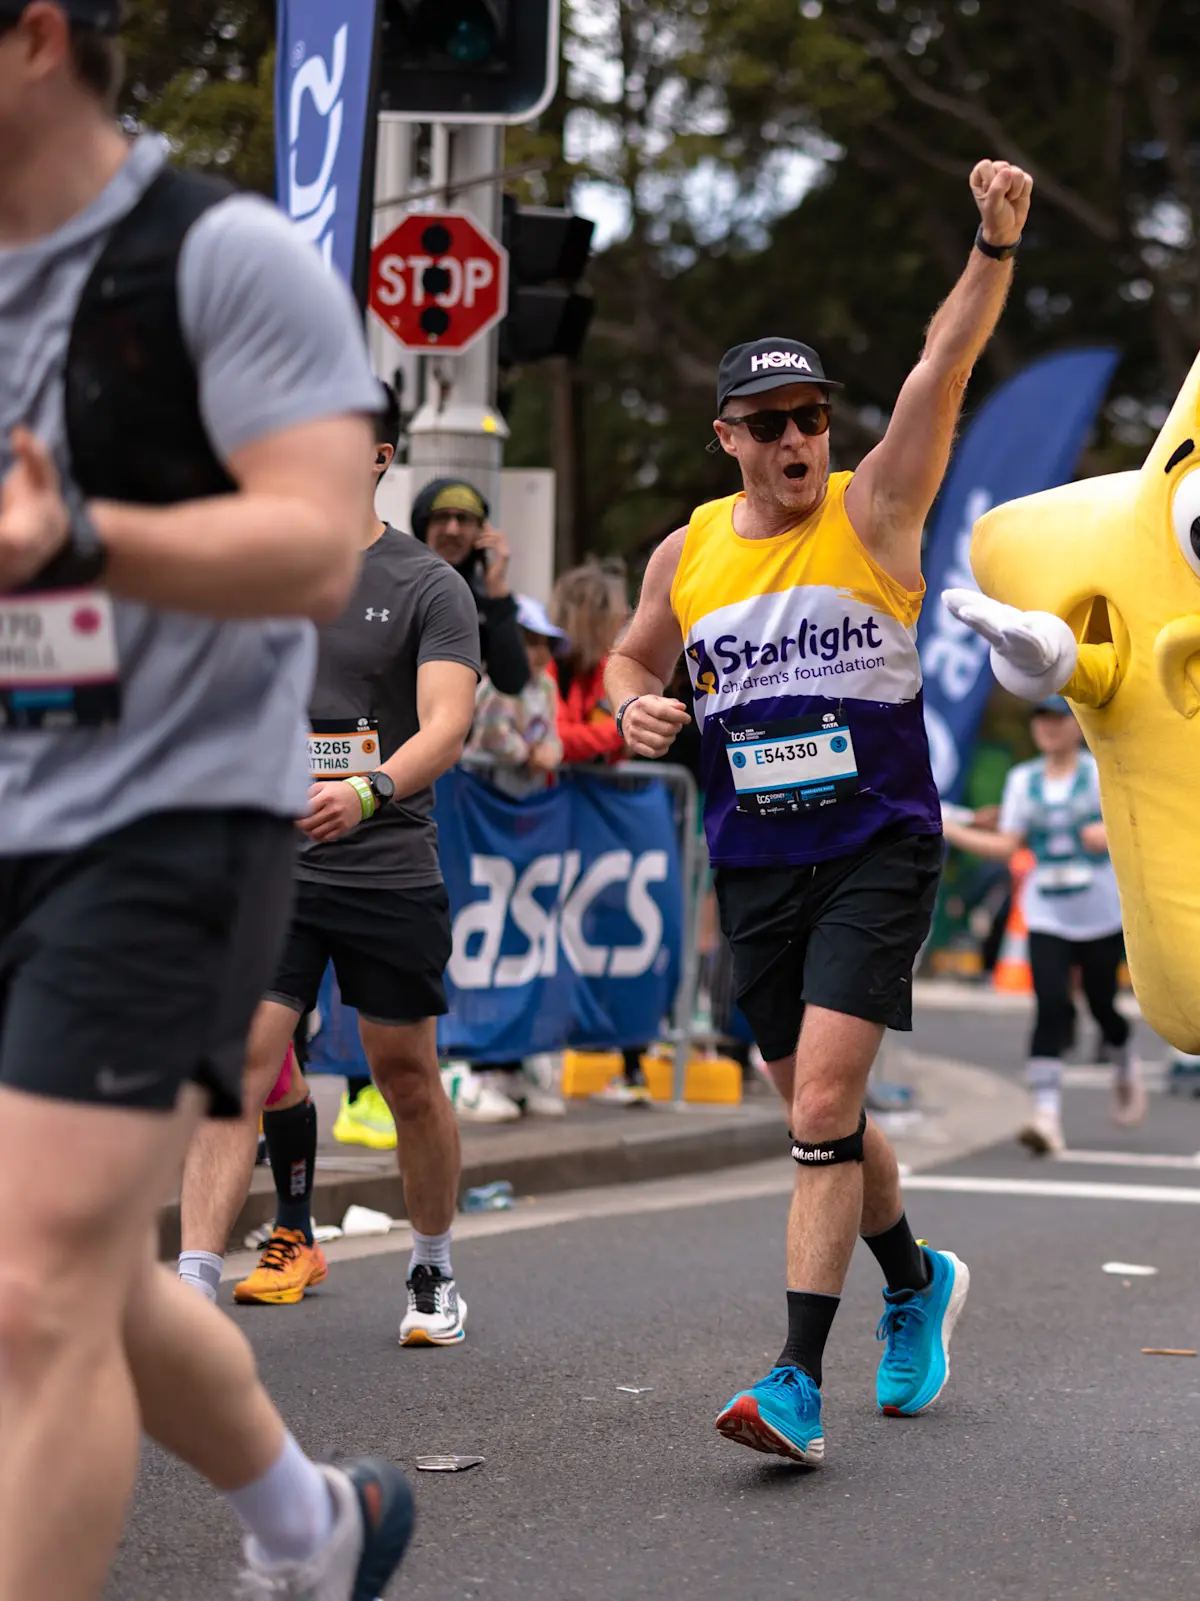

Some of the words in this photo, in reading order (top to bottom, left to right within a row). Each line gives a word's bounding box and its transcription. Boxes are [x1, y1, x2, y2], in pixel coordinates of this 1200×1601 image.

[377, 253, 494, 308] STOP
[751, 351, 812, 372] HOKA
[713, 616, 883, 675] Starlight
[794, 656, 885, 681] foundation
[821, 722, 839, 730] TATA
[730, 731, 746, 742] tcs
[366, 742, 371, 750] 3
[835, 740, 842, 749] 3
[754, 742, 818, 765] E54330
[756, 794, 771, 805] tcs
[791, 1146, 835, 1161] Mueller
